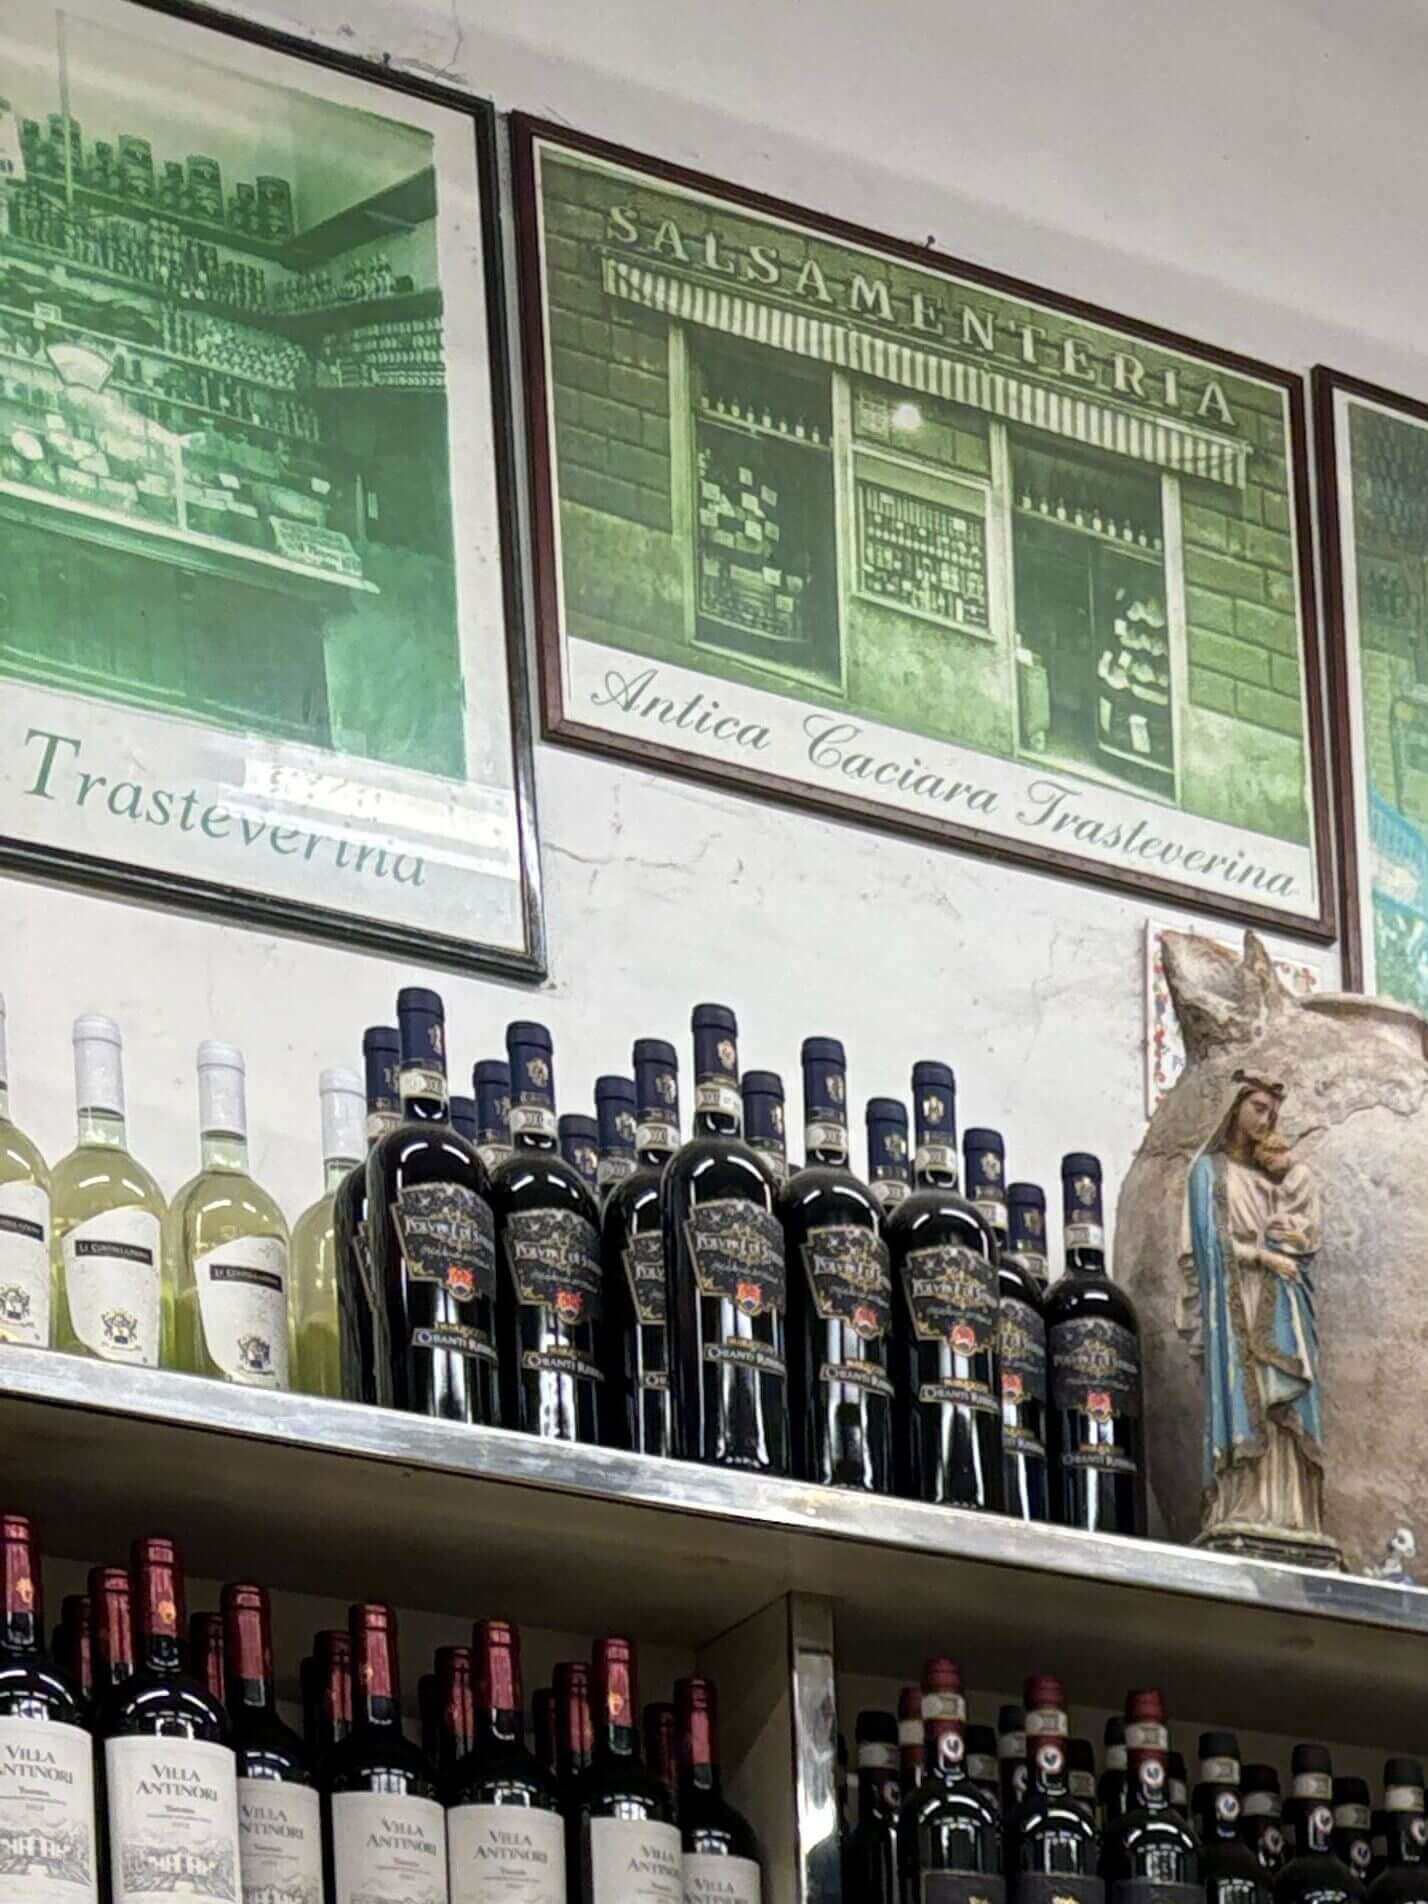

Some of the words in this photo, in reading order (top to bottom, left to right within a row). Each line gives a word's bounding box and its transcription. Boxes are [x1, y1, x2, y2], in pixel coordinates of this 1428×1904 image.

[608, 203, 1238, 429] SALSAMENTERIA
[591, 669, 772, 751] Antica
[804, 713, 1001, 818] Caciara
[1017, 781, 1299, 899] Trasteverina
[24, 727, 427, 888] Trasteverina
[6, 1745, 56, 1764] VILLA
[151, 1764, 201, 1782] VILLA
[136, 1780, 219, 1801] ANTINORI
[382, 1816, 425, 1839] VILLA
[489, 1830, 533, 1847] VILLA
[366, 1833, 437, 1856] ANTINORI
[473, 1845, 549, 1864] ANTINORI
